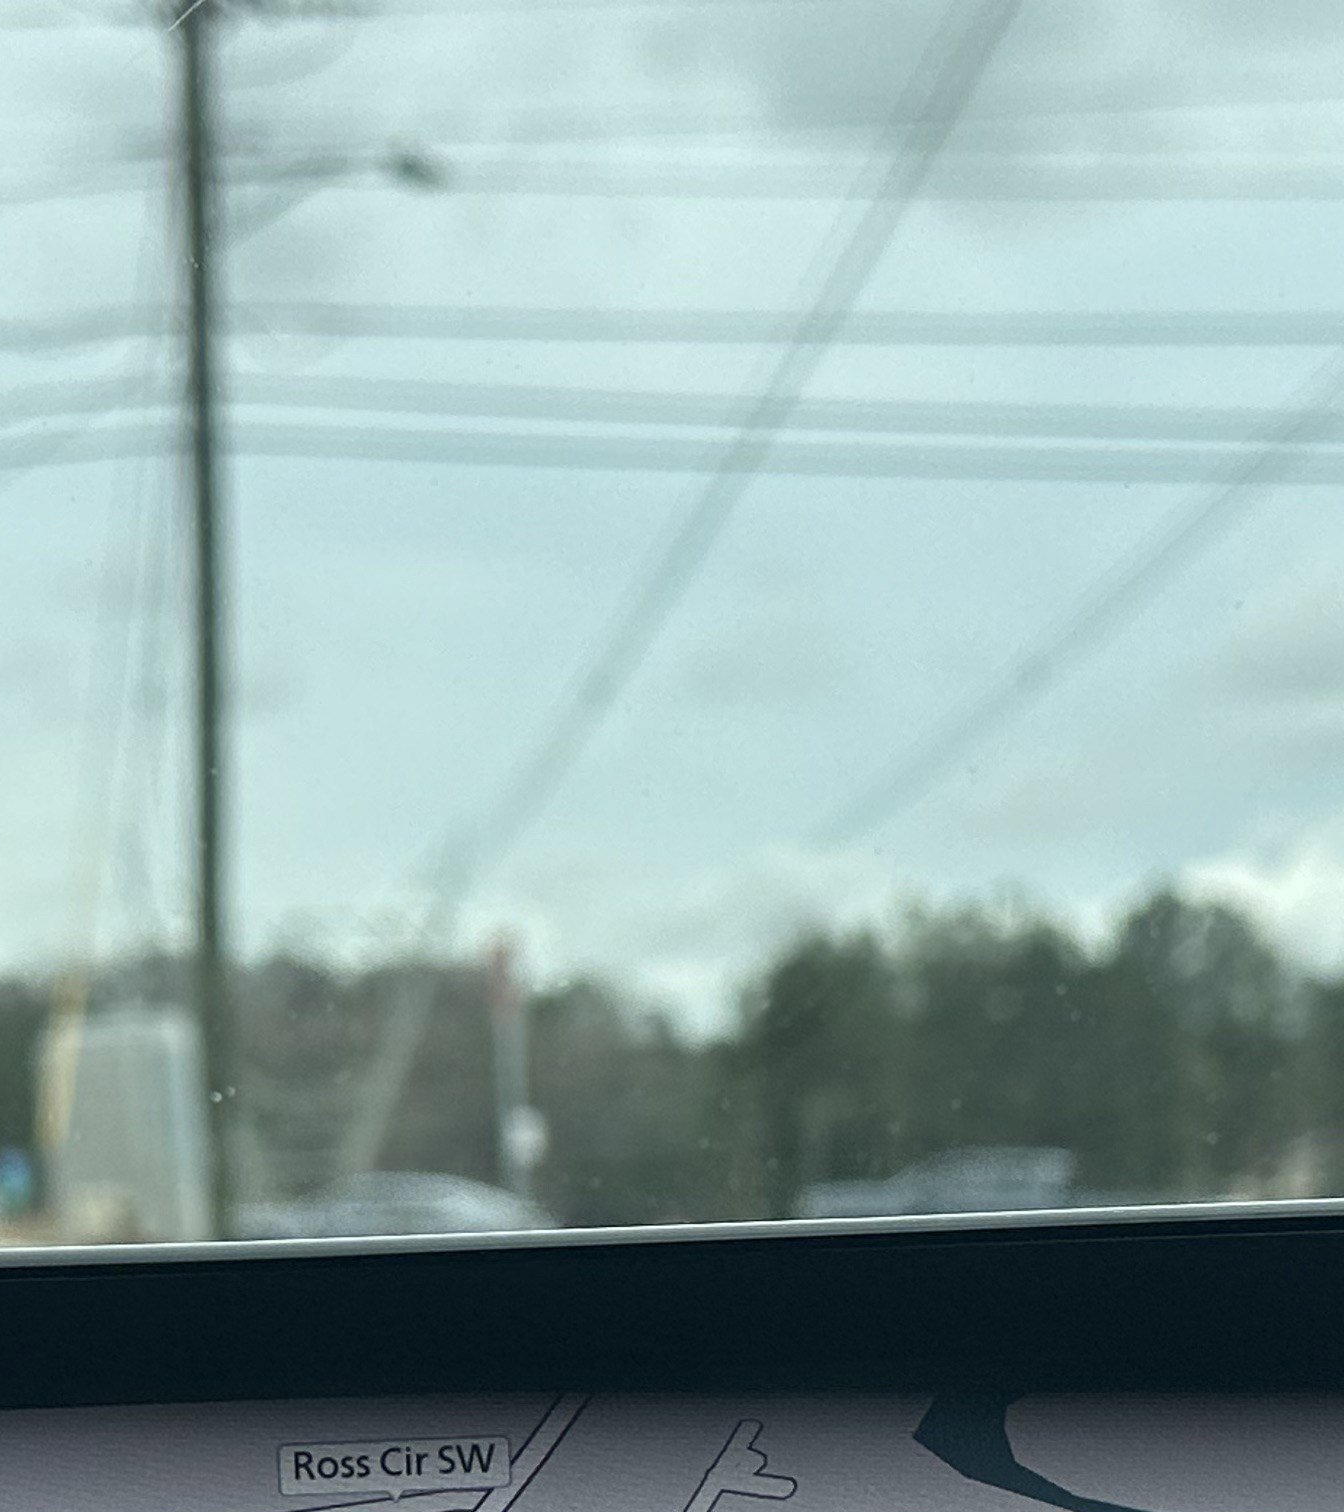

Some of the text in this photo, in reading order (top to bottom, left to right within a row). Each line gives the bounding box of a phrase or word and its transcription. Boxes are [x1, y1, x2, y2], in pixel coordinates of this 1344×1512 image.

[293, 1443, 496, 1481] Ross Cir SW
